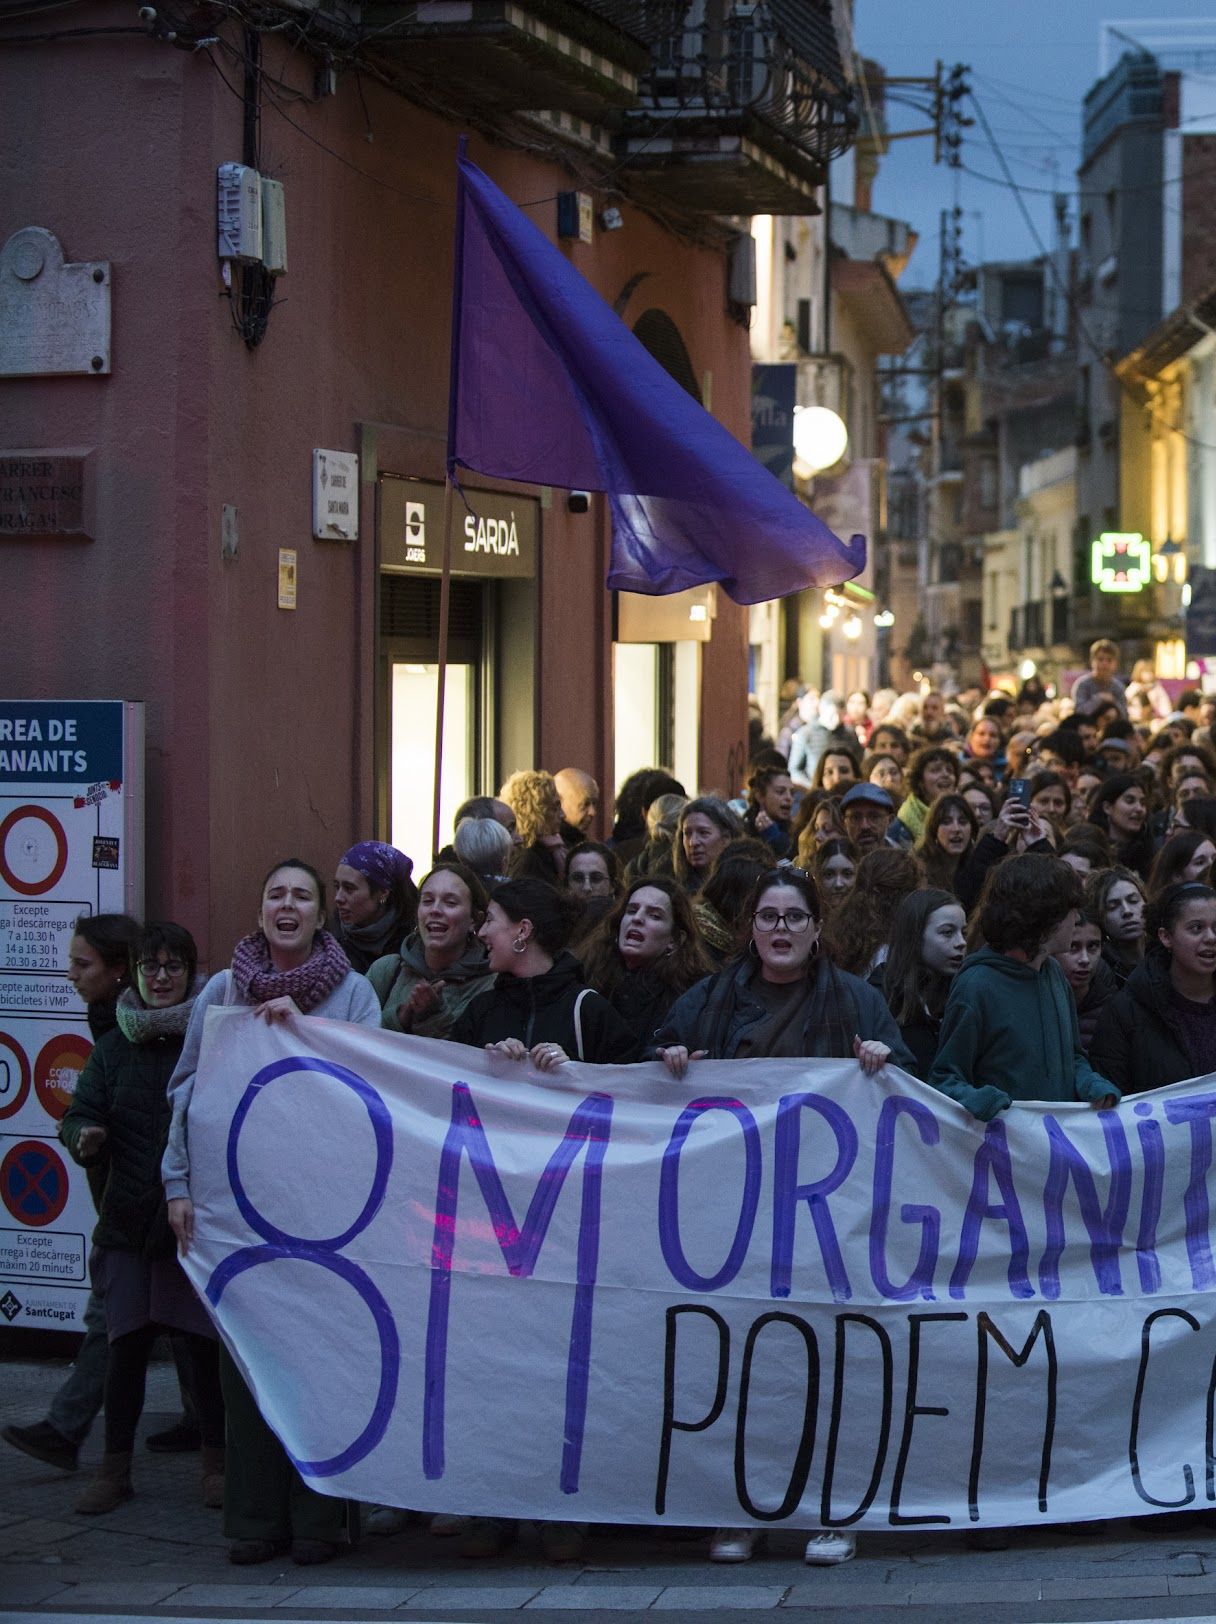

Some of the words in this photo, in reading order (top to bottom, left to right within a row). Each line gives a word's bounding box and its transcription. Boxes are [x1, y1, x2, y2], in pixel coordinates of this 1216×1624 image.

[464, 510, 520, 556] SARDÀ
[48, 719, 77, 741] DE
[13, 904, 49, 917] Excepte
[17, 917, 68, 932] descàrrega
[8, 930, 14, 941] 7
[15, 932, 21, 941] a
[23, 931, 47, 942] 10.30
[49, 931, 55, 942] h
[6, 943, 16, 954] 14
[18, 945, 24, 954] a
[26, 944, 50, 955] 16.30
[52, 944, 58, 955] h
[5, 956, 30, 967] 20.30
[31, 959, 37, 968] a
[39, 957, 50, 968] 22
[52, 957, 58, 968] h
[24, 983, 76, 996] autoritzats,
[0, 994, 43, 1006] bicicletes
[48, 996, 70, 1007] VMP
[17, 1234, 53, 1248] Excepte
[30, 1248, 81, 1264] descàrrega
[29, 1261, 40, 1272] 20
[42, 1262, 74, 1274] minuts
[25, 1299, 67, 1309] AJUNTAMENT
[68, 1302, 77, 1310] DE
[25, 1306, 76, 1321] SantCugat
[655, 1303, 1059, 1528] PODEM
